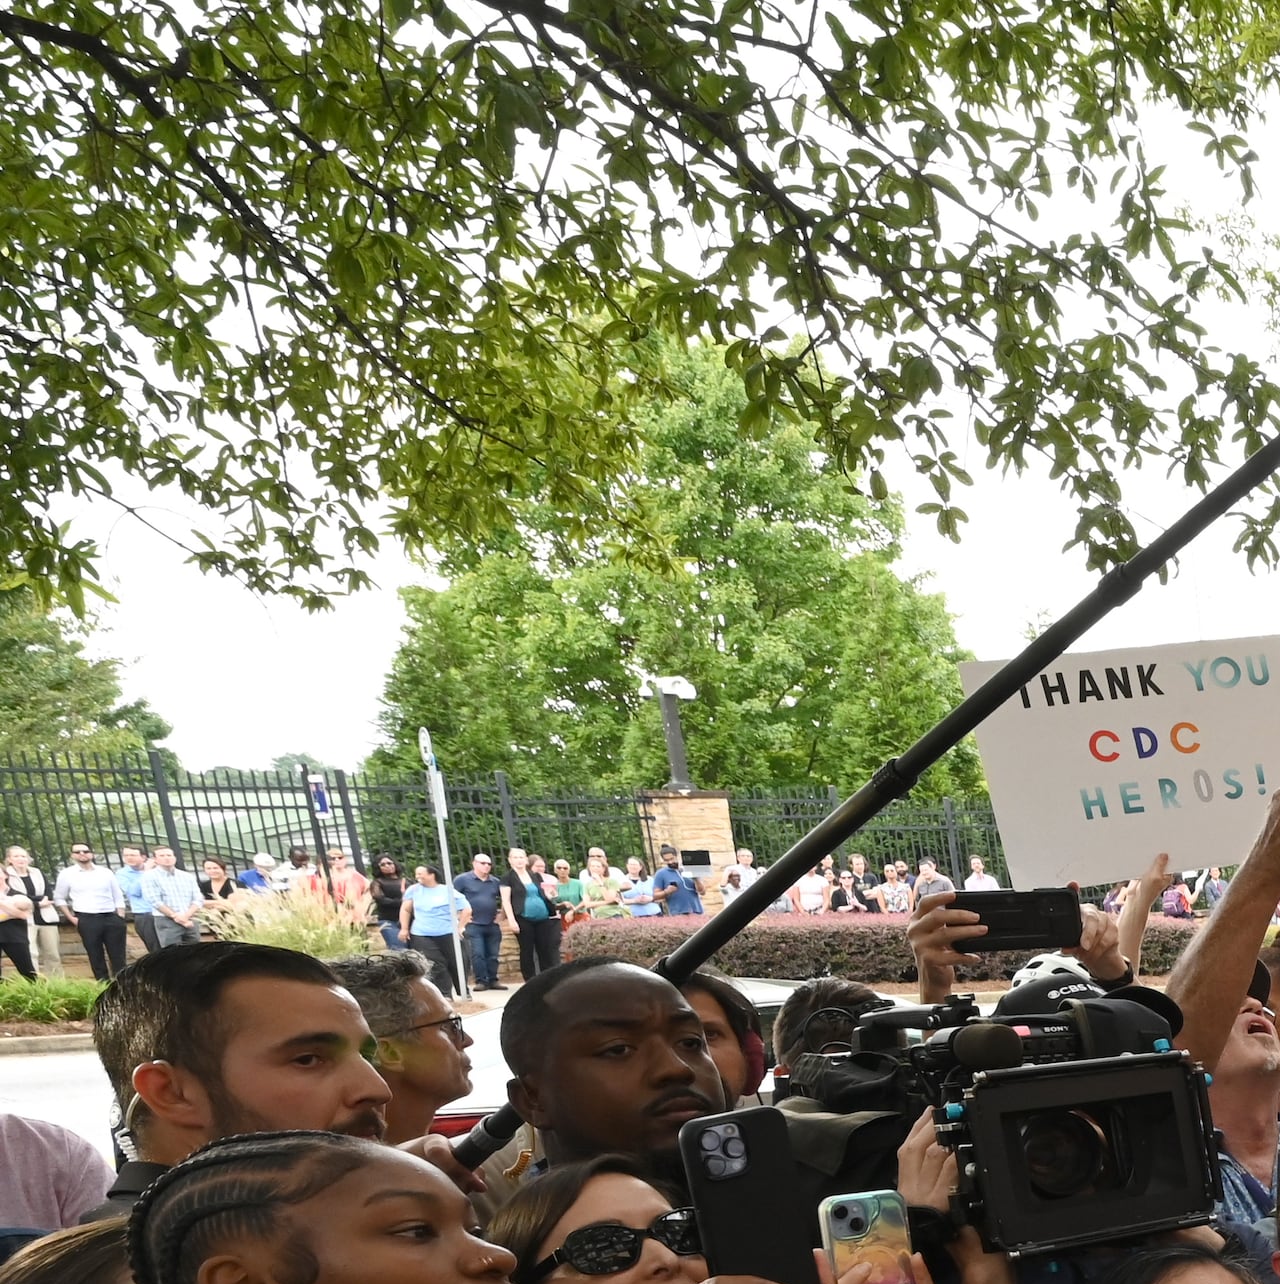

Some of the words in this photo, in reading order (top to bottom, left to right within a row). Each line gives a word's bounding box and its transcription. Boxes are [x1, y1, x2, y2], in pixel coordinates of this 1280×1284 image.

[1020, 664, 1164, 708] THANK
[1183, 655, 1270, 691] YOU
[1089, 722, 1200, 762] CDC
[1080, 763, 1266, 820] HEROS!
[1060, 984, 1087, 994] CBS
[1043, 1025, 1069, 1033] SONY
